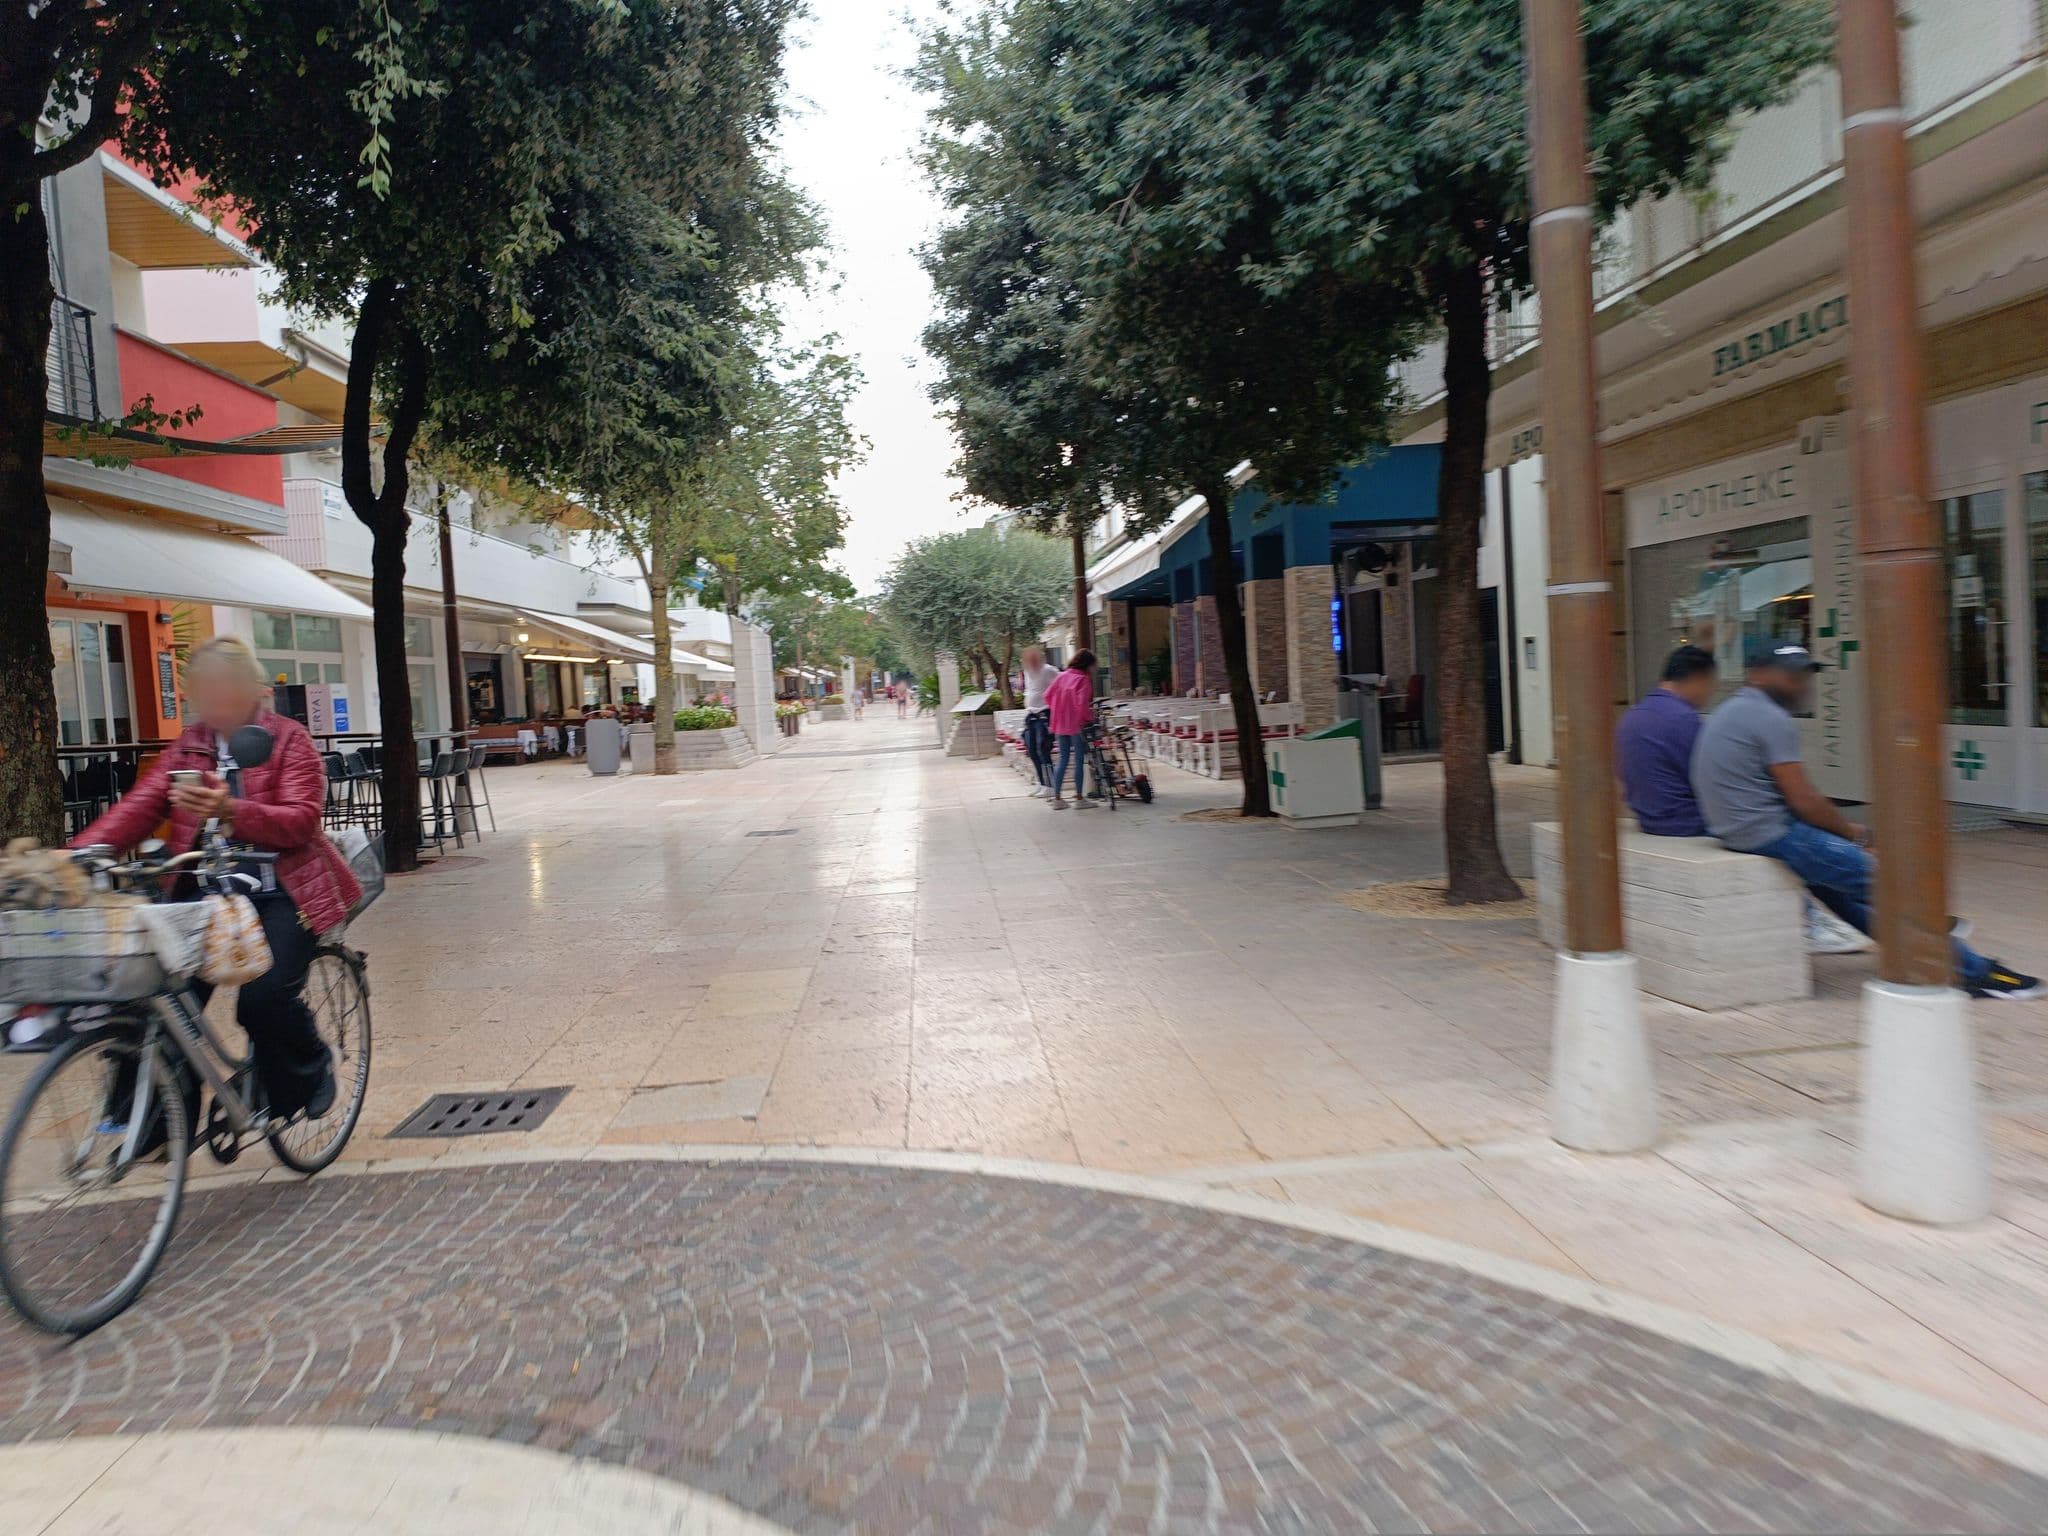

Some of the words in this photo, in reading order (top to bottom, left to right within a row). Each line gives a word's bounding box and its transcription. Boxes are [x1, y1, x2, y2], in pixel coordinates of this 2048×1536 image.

[1655, 464, 1796, 525] APOTHEKE
[311, 698, 323, 734] ERYA
[1821, 645, 1841, 769] FARMACIA
